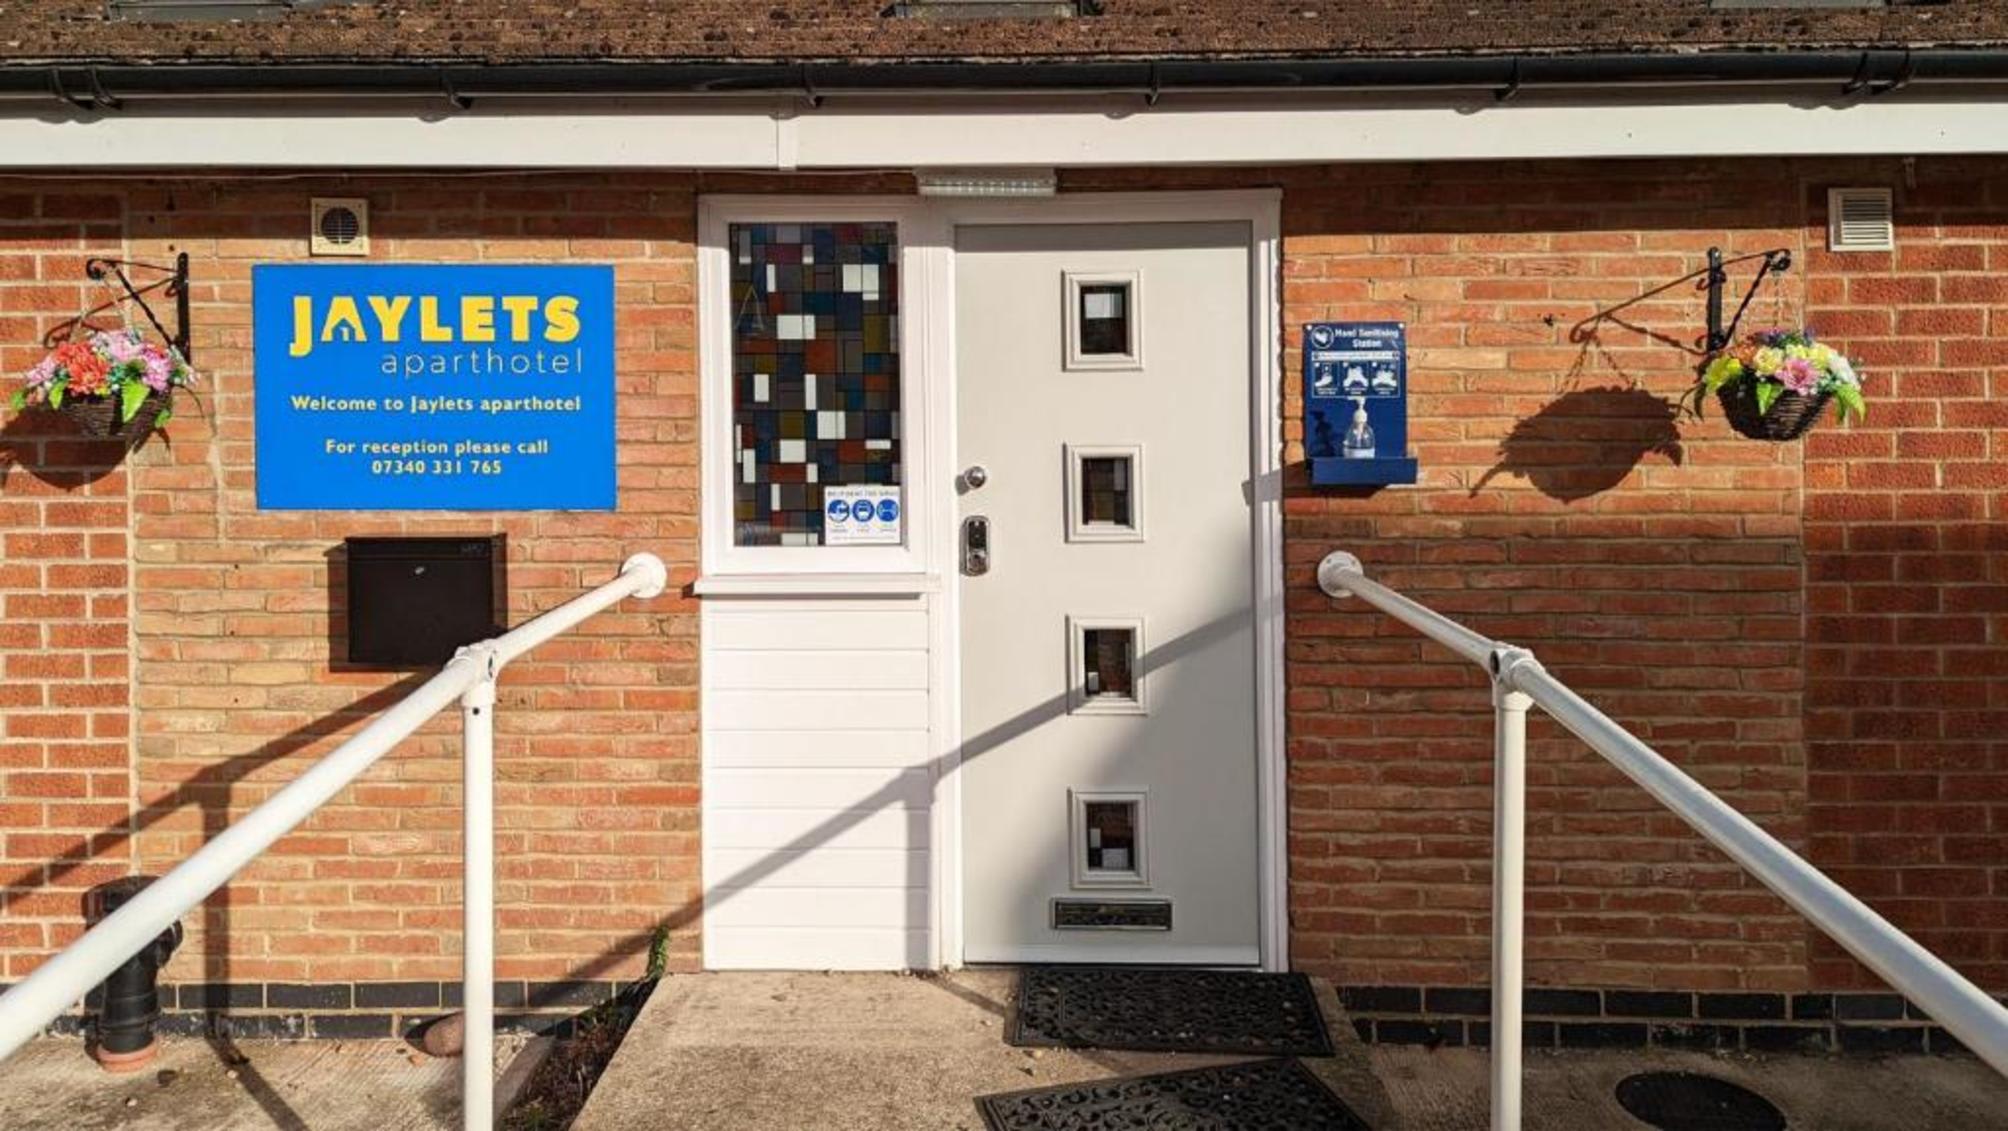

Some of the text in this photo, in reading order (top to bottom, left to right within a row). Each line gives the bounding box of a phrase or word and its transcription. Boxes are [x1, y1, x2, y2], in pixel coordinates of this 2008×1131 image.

[289, 296, 581, 357] JAYLETS
[1351, 338, 1382, 348] Station
[381, 347, 583, 379] aparthotel
[291, 395, 581, 413] Welcome to Jaylets aparthotel
[325, 438, 549, 457] For reception please call
[372, 460, 502, 475] 07340 331 765
